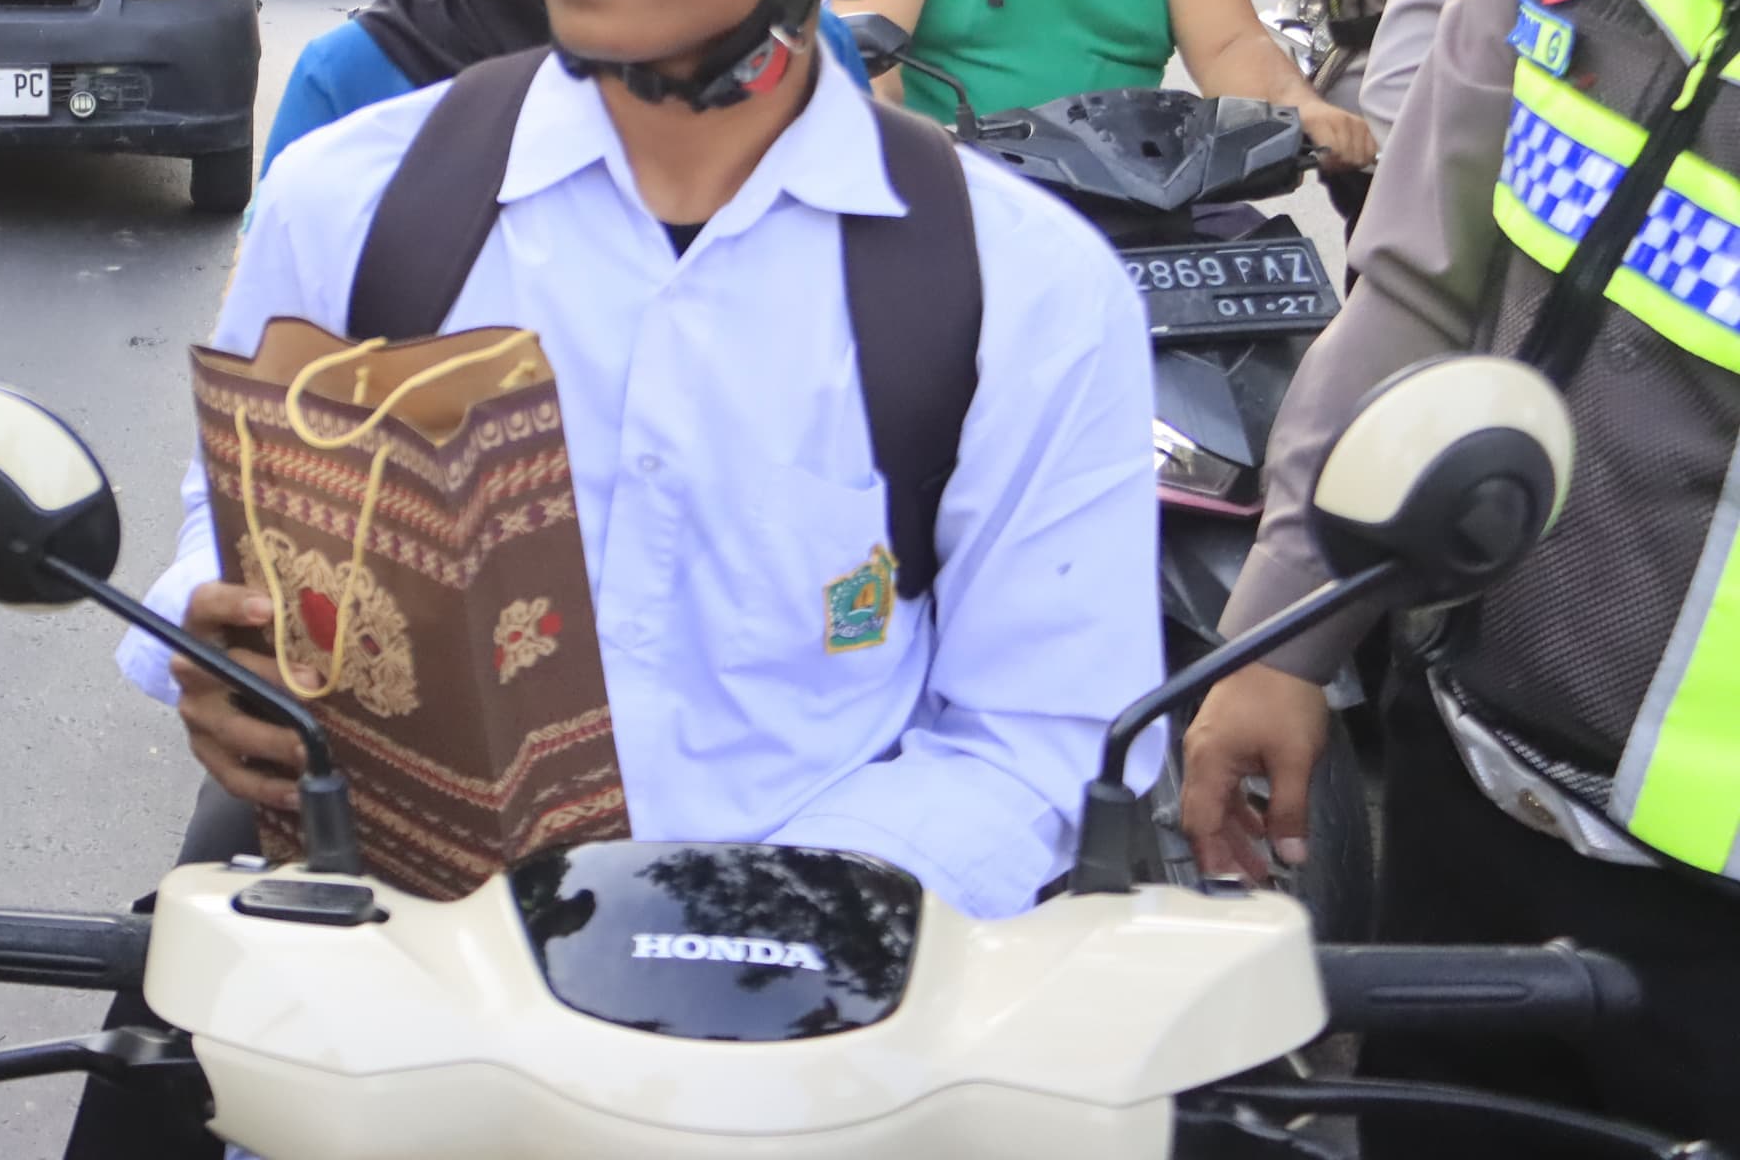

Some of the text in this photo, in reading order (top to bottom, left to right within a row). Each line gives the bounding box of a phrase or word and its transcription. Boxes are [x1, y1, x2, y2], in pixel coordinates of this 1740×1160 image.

[14, 72, 43, 98] PC
[1126, 253, 1311, 289] 2869 PAZ
[632, 933, 827, 971] HONDA
